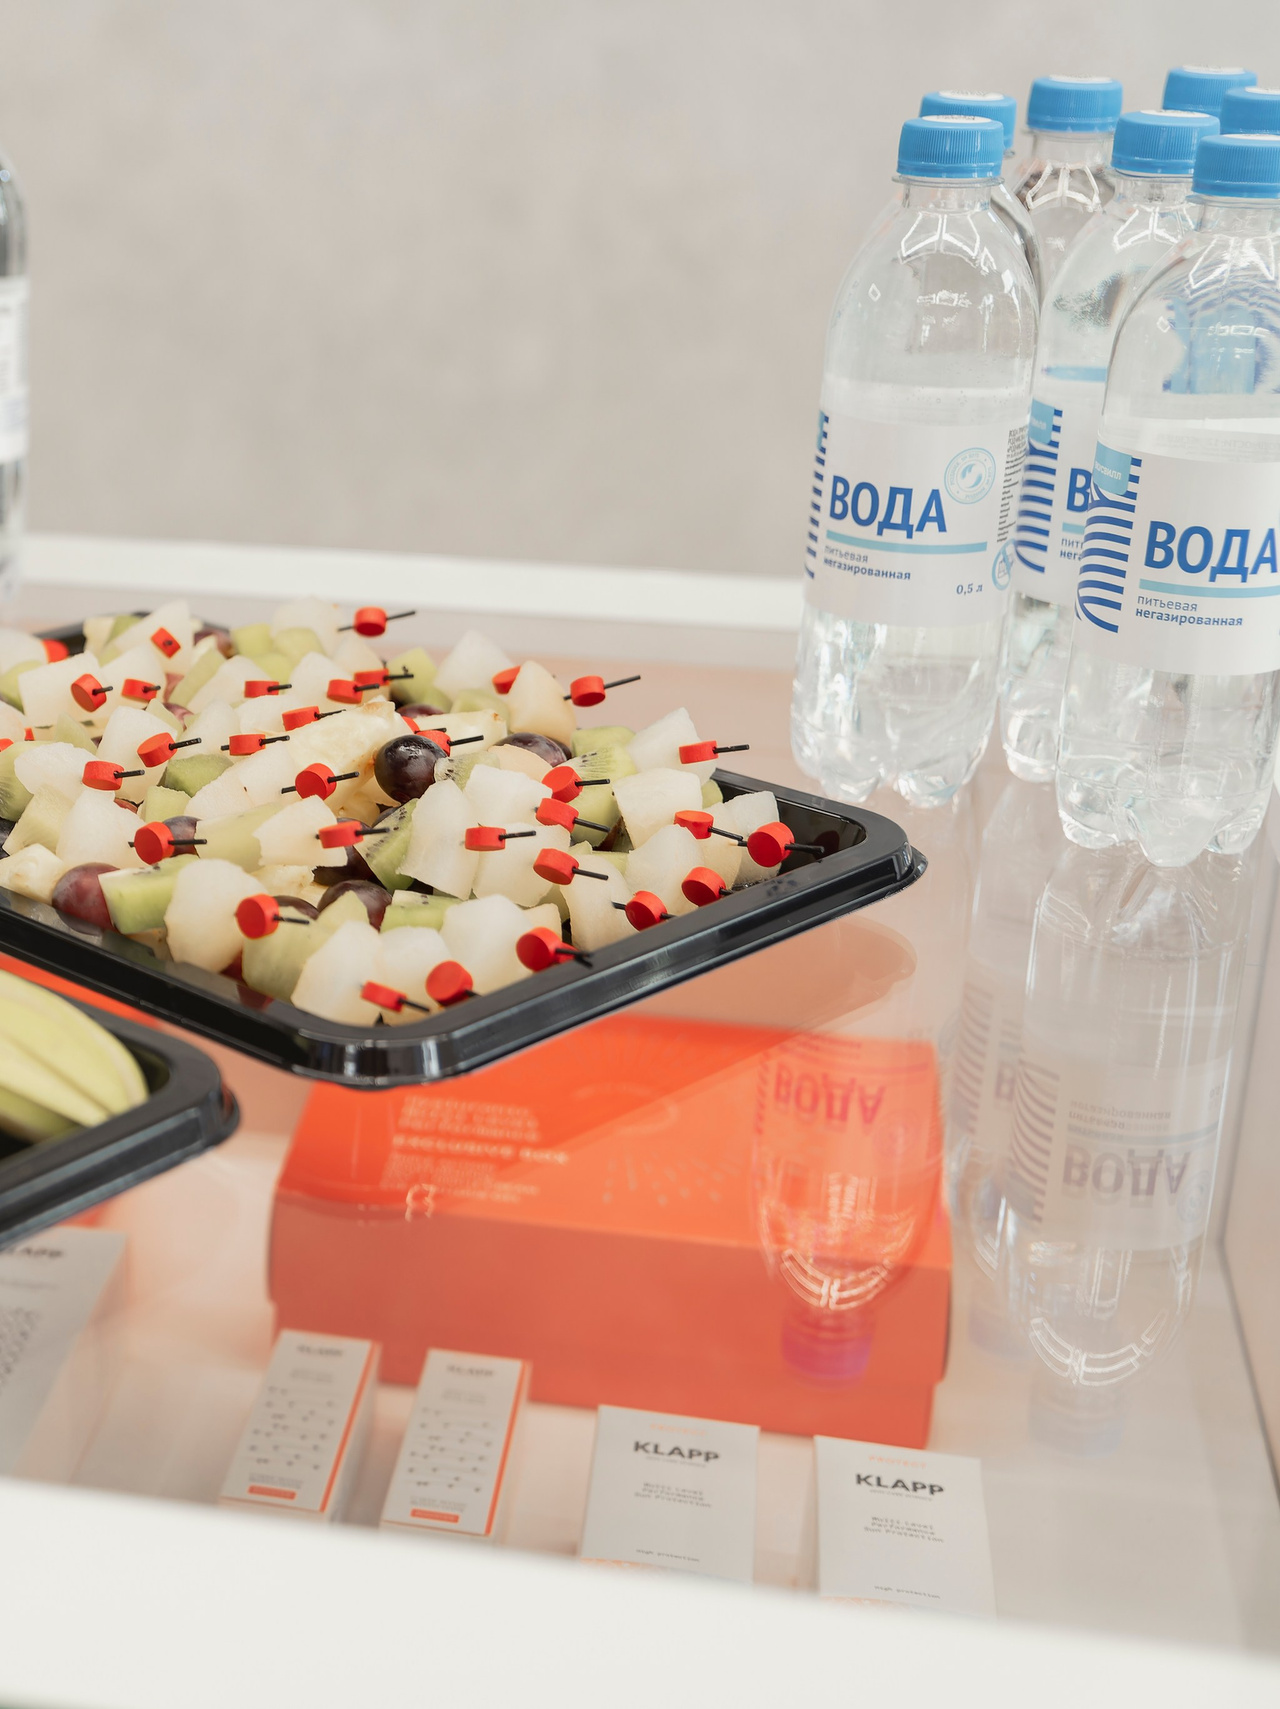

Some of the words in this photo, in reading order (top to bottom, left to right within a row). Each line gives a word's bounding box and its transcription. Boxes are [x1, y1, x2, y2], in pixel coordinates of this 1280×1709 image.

[829, 475, 947, 539] ВОДА
[824, 545, 868, 563] питьевая
[1144, 520, 1278, 583] ВОДА
[823, 558, 911, 580] негазированная
[956, 583, 974, 596] 0,5
[976, 584, 983, 593] л
[1137, 596, 1198, 612] питьевая
[1135, 608, 1243, 626] негазированная
[633, 1441, 720, 1462] KLAPP
[855, 1473, 944, 1495] KLAPP
